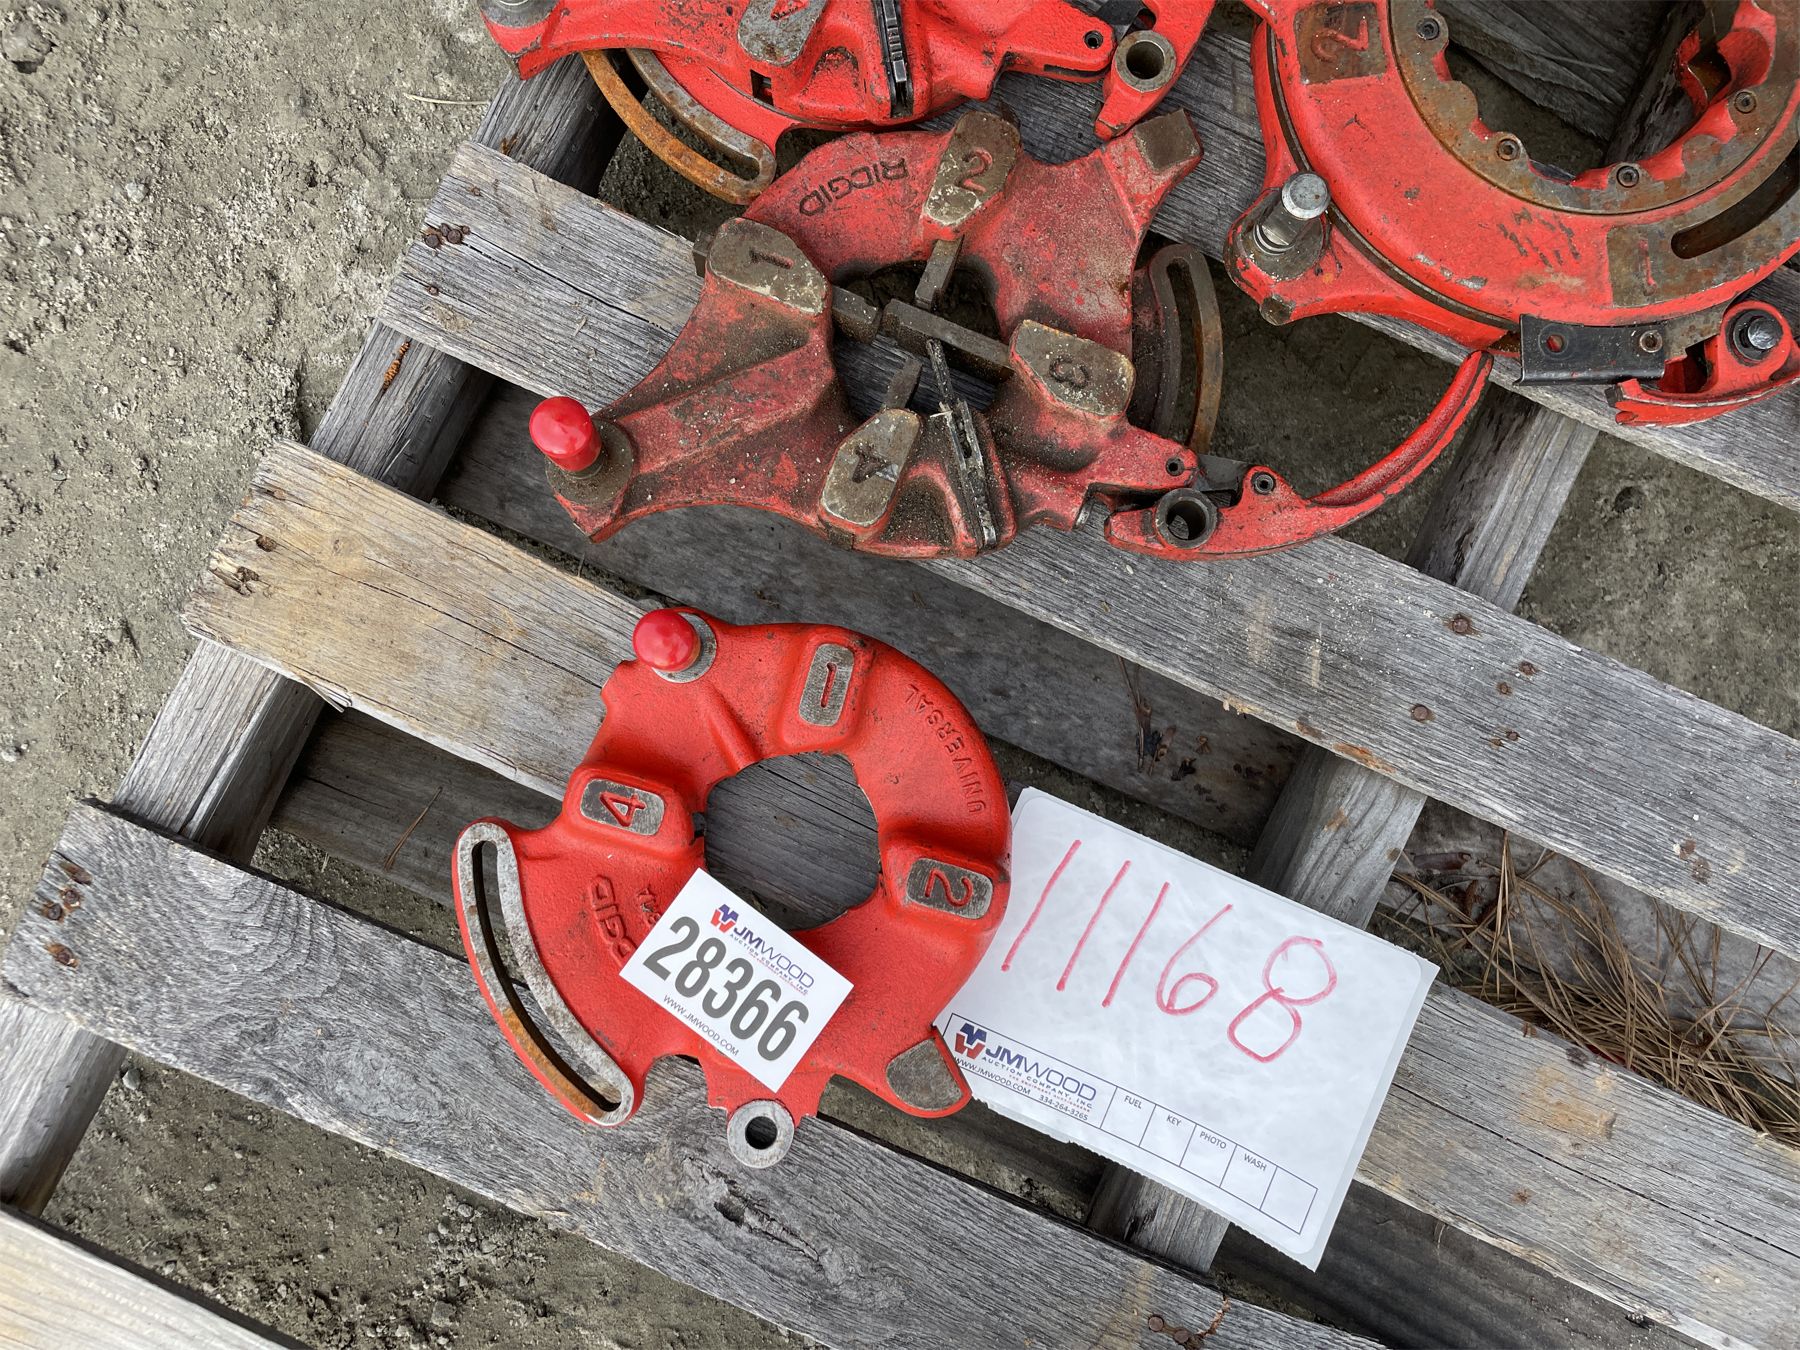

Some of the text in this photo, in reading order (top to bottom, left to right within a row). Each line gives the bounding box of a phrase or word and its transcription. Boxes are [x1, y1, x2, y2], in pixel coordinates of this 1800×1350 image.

[800, 157, 910, 217] RIDGID
[954, 149, 993, 194] 2
[905, 684, 987, 814] UNIVERSAL
[599, 791, 647, 828] 4
[923, 868, 974, 908] 2
[730, 934, 759, 957] AUCTION
[733, 926, 814, 988] JMWOOD
[1000, 839, 1337, 1063] 11168
[642, 915, 810, 1062] 28366
[663, 994, 740, 1056] WWW.JMWOOD.COM
[954, 1057, 1089, 1121] WWW.JMWOOD.COM 334-264-3265
[982, 1056, 1022, 1077] AUCTION
[985, 1045, 1097, 1101] JMWOOD
[1124, 1095, 1142, 1110] FUEL
[1166, 1114, 1181, 1127] KEY
[1199, 1131, 1227, 1149] PHOTO
[1243, 1153, 1268, 1172] WASH
